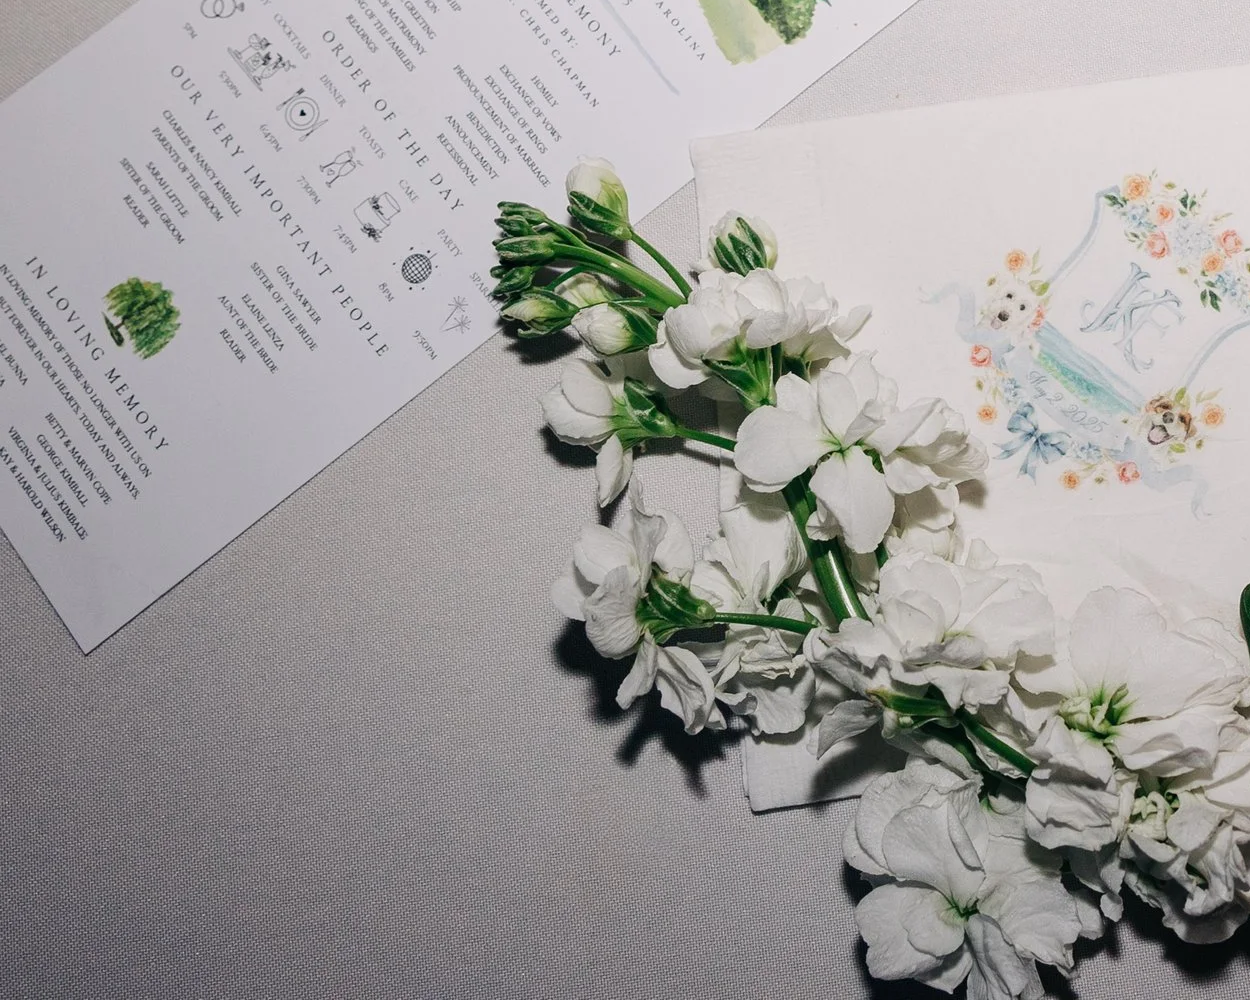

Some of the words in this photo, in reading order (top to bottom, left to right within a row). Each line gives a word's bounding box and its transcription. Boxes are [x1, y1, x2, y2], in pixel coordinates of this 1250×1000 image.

[273, 13, 311, 60] COCKTAILS
[345, 13, 379, 54] READINGS
[404, 0, 437, 40] GREETING
[560, 27, 578, 48] BY:
[519, 9, 551, 46] CHRIS
[551, 49, 600, 108] CHAPMAN
[319, 74, 347, 108] DINNER
[530, 75, 559, 108] HOMILY
[322, 30, 371, 93] ORDER
[374, 99, 396, 121] OF
[397, 128, 430, 167] THE
[429, 172, 464, 210] DAY
[359, 125, 386, 159] TOASTS
[445, 115, 500, 180] ANNOUNCEMENT
[453, 64, 511, 134] PRONOUNCEMENT
[506, 133, 519, 145] OF
[514, 144, 551, 188] MARRIAGE
[466, 111, 510, 165] BENEDICTION
[162, 110, 192, 147] CHARLES
[188, 145, 196, 154] &
[193, 152, 218, 181] NANCY
[213, 179, 242, 217] KIMBALL
[436, 132, 479, 187] RECESSIONAL
[123, 194, 150, 229] READER
[145, 161, 170, 191] SARAH
[164, 188, 189, 218] LITTLE
[171, 65, 202, 105] OUR
[206, 109, 244, 157] VERY
[243, 164, 333, 276] IMPORTANT
[331, 284, 389, 357] PEOPLE
[398, 179, 420, 203] CAKE
[437, 228, 463, 257] PARTY
[241, 293, 267, 325] ELAINE
[262, 322, 285, 352] LENZA
[250, 262, 275, 292] SISTER
[271, 291, 285, 304] OF
[281, 303, 298, 325] THE
[294, 323, 318, 352] BRIDE
[276, 265, 295, 290] GINA
[292, 288, 322, 325] SAWYER
[25, 256, 48, 280] IN
[46, 285, 105, 361] LOVING
[104, 367, 169, 450] MEMORY
[219, 328, 247, 363] READER
[36, 434, 64, 470] GEORGE
[59, 467, 89, 508] KIMBALL
[44, 412, 68, 440] BETTY
[63, 439, 72, 448] &
[68, 446, 97, 482] MARVIN
[92, 480, 112, 505] COPE
